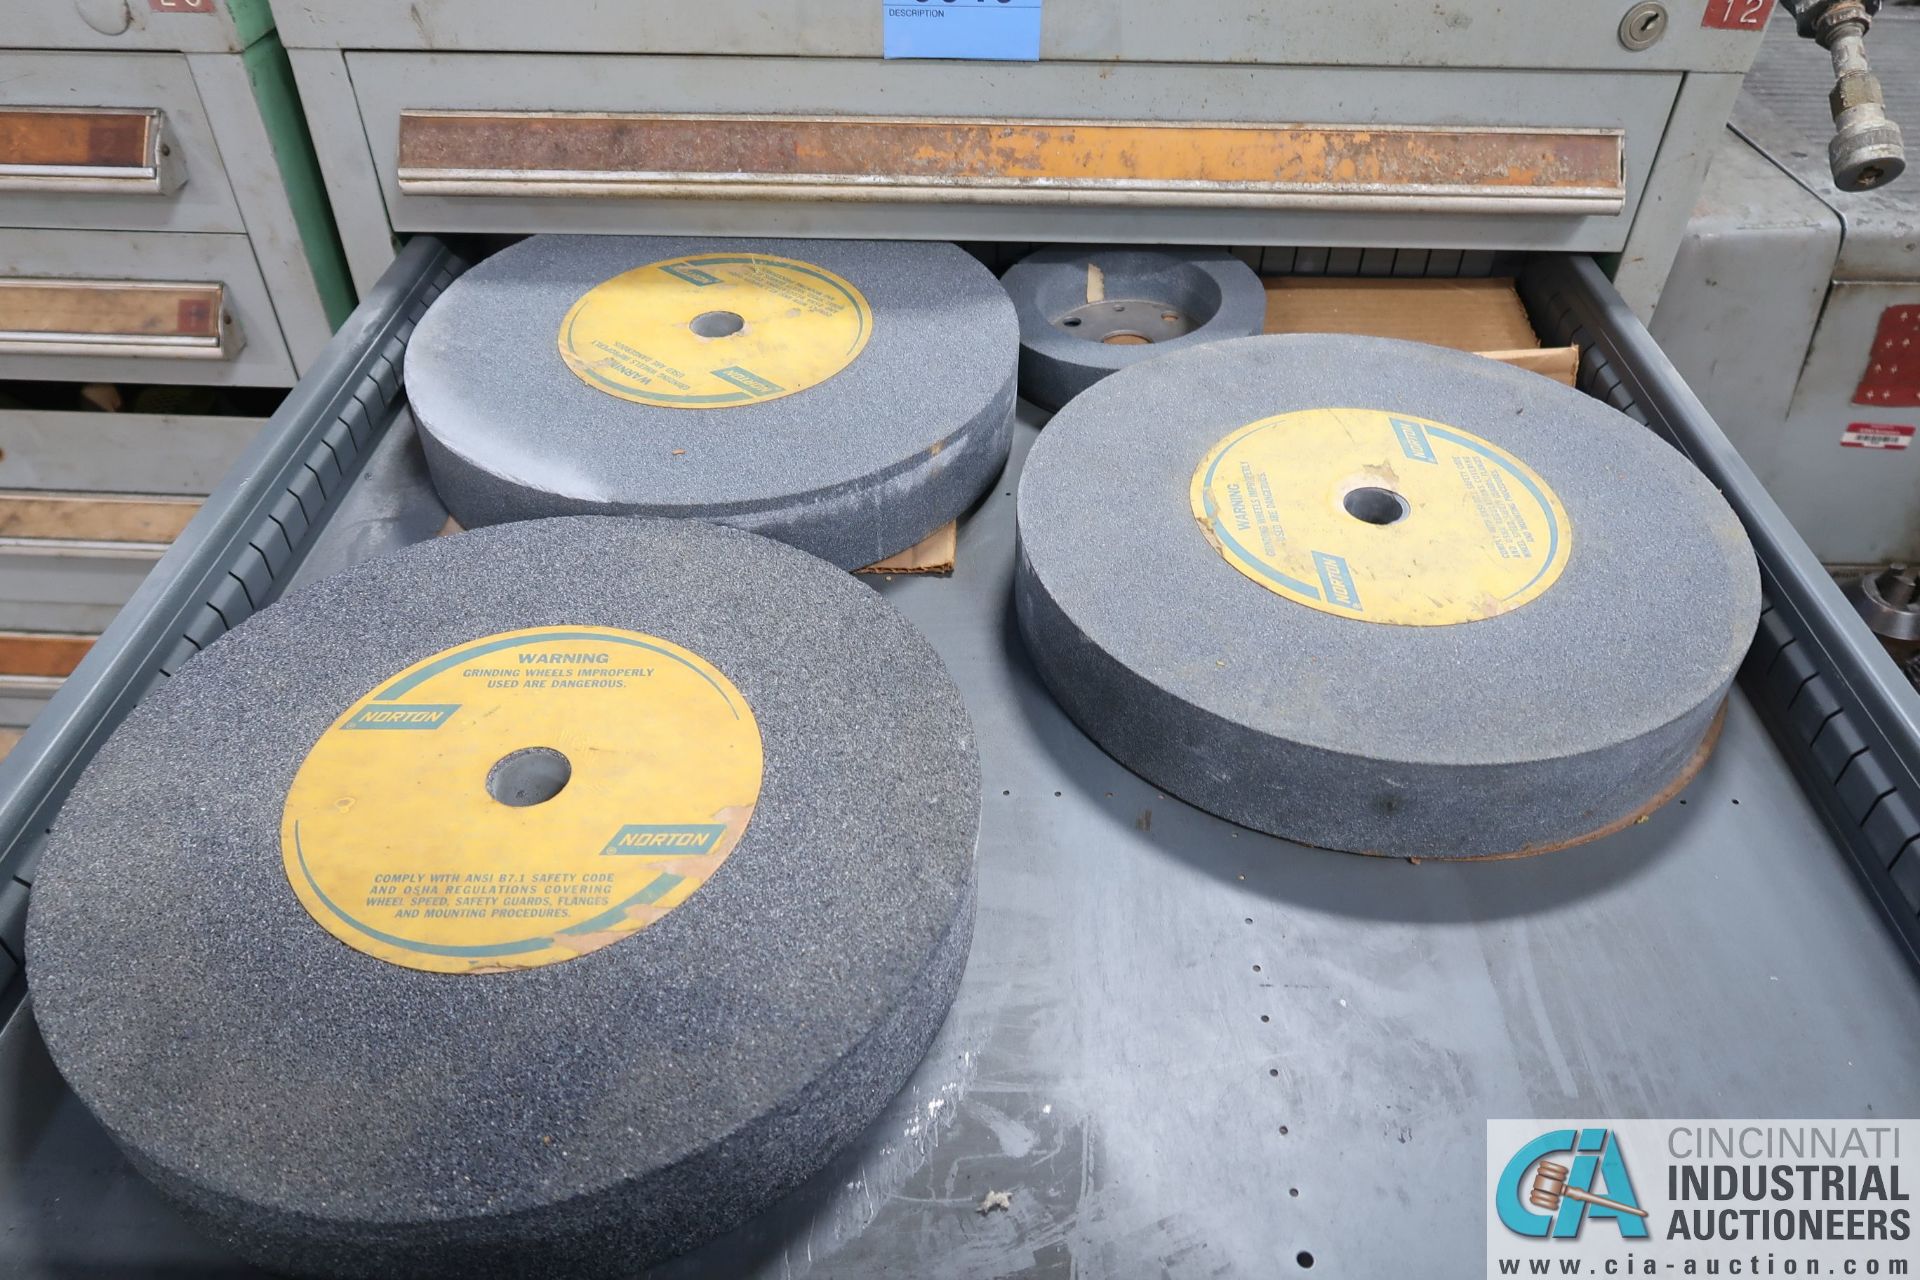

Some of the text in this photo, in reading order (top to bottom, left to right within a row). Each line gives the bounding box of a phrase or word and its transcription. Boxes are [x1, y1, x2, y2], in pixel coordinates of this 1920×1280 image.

[888, 9, 945, 18] DESCRIPTION
[1227, 483, 1251, 531] WARNING
[1322, 557, 1351, 603] NORTON
[518, 653, 609, 664] WARNING
[463, 668, 654, 677] GRINDING WHEELS IMPROPERLY
[487, 679, 627, 689] USED ARE DANGEROUS.
[358, 711, 444, 722] NORTON
[618, 833, 710, 847] NORTON
[374, 873, 425, 883] COMPLY
[430, 873, 460, 882] WITH
[464, 873, 494, 883] ANSI
[531, 873, 577, 882] SAFETY
[582, 873, 615, 882] CODE
[369, 885, 612, 895] AND OSHA REGULATIONS COVERING
[366, 896, 404, 906] WHEEL
[455, 896, 498, 906] SAFETY
[558, 896, 609, 906] FLANGES
[394, 908, 571, 918] AND MOUNTING PROCEDURES.
